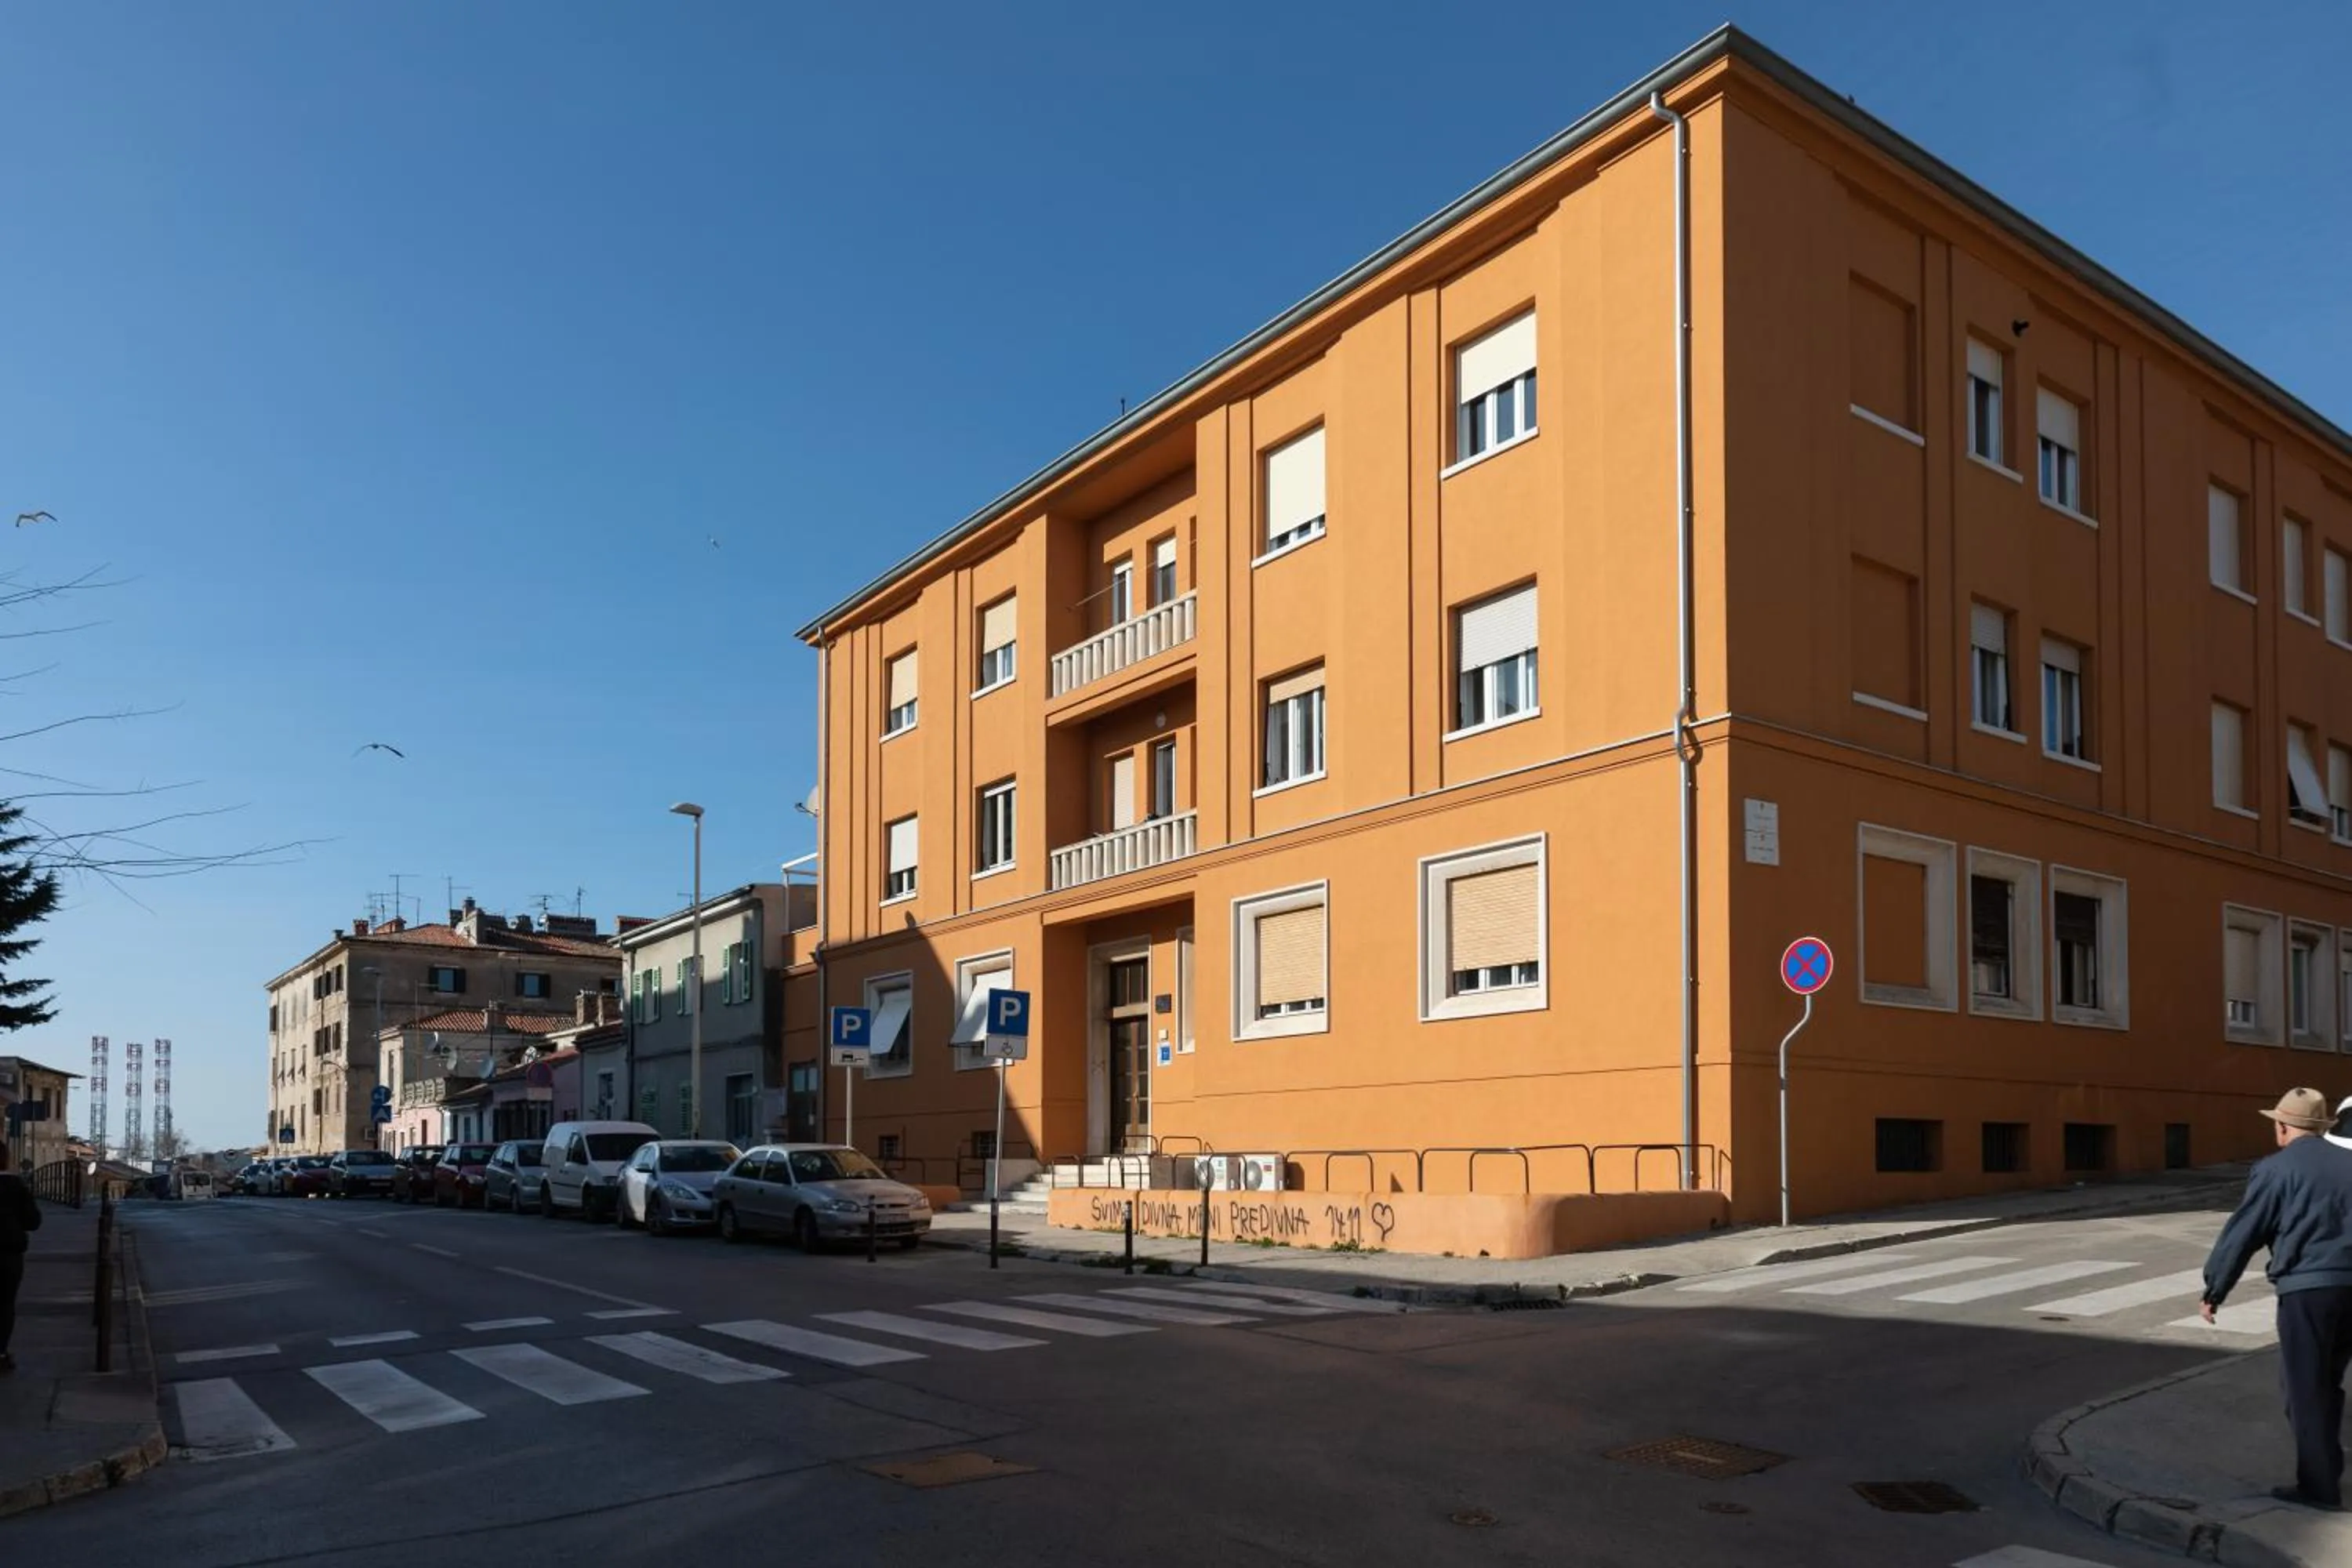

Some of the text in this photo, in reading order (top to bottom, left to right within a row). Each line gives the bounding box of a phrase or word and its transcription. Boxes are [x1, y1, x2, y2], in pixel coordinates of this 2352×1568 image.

[999, 996, 1022, 1026] P
[841, 1014, 862, 1040] P
[1091, 1196, 1129, 1225] SVIM
[1229, 1201, 1310, 1237] PREDIVNA
